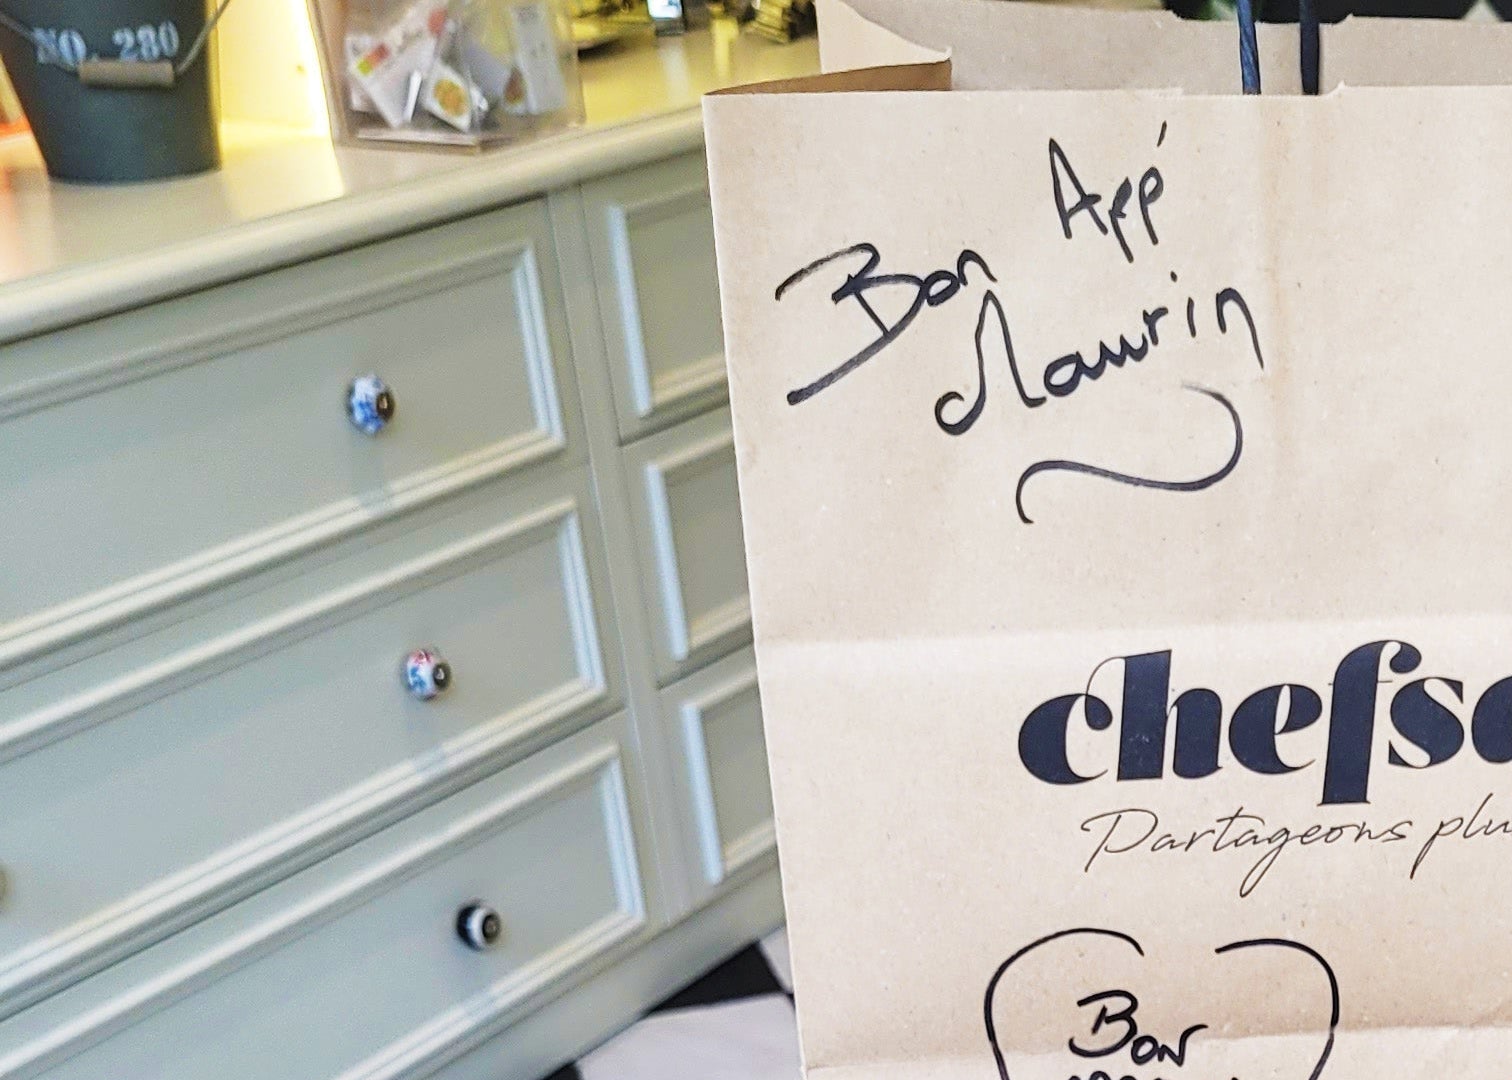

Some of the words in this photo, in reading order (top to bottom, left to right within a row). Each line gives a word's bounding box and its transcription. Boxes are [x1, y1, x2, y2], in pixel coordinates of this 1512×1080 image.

[112, 20, 179, 62] 280
[774, 242, 997, 406] Bon
[1081, 806, 1413, 898] Partageons
